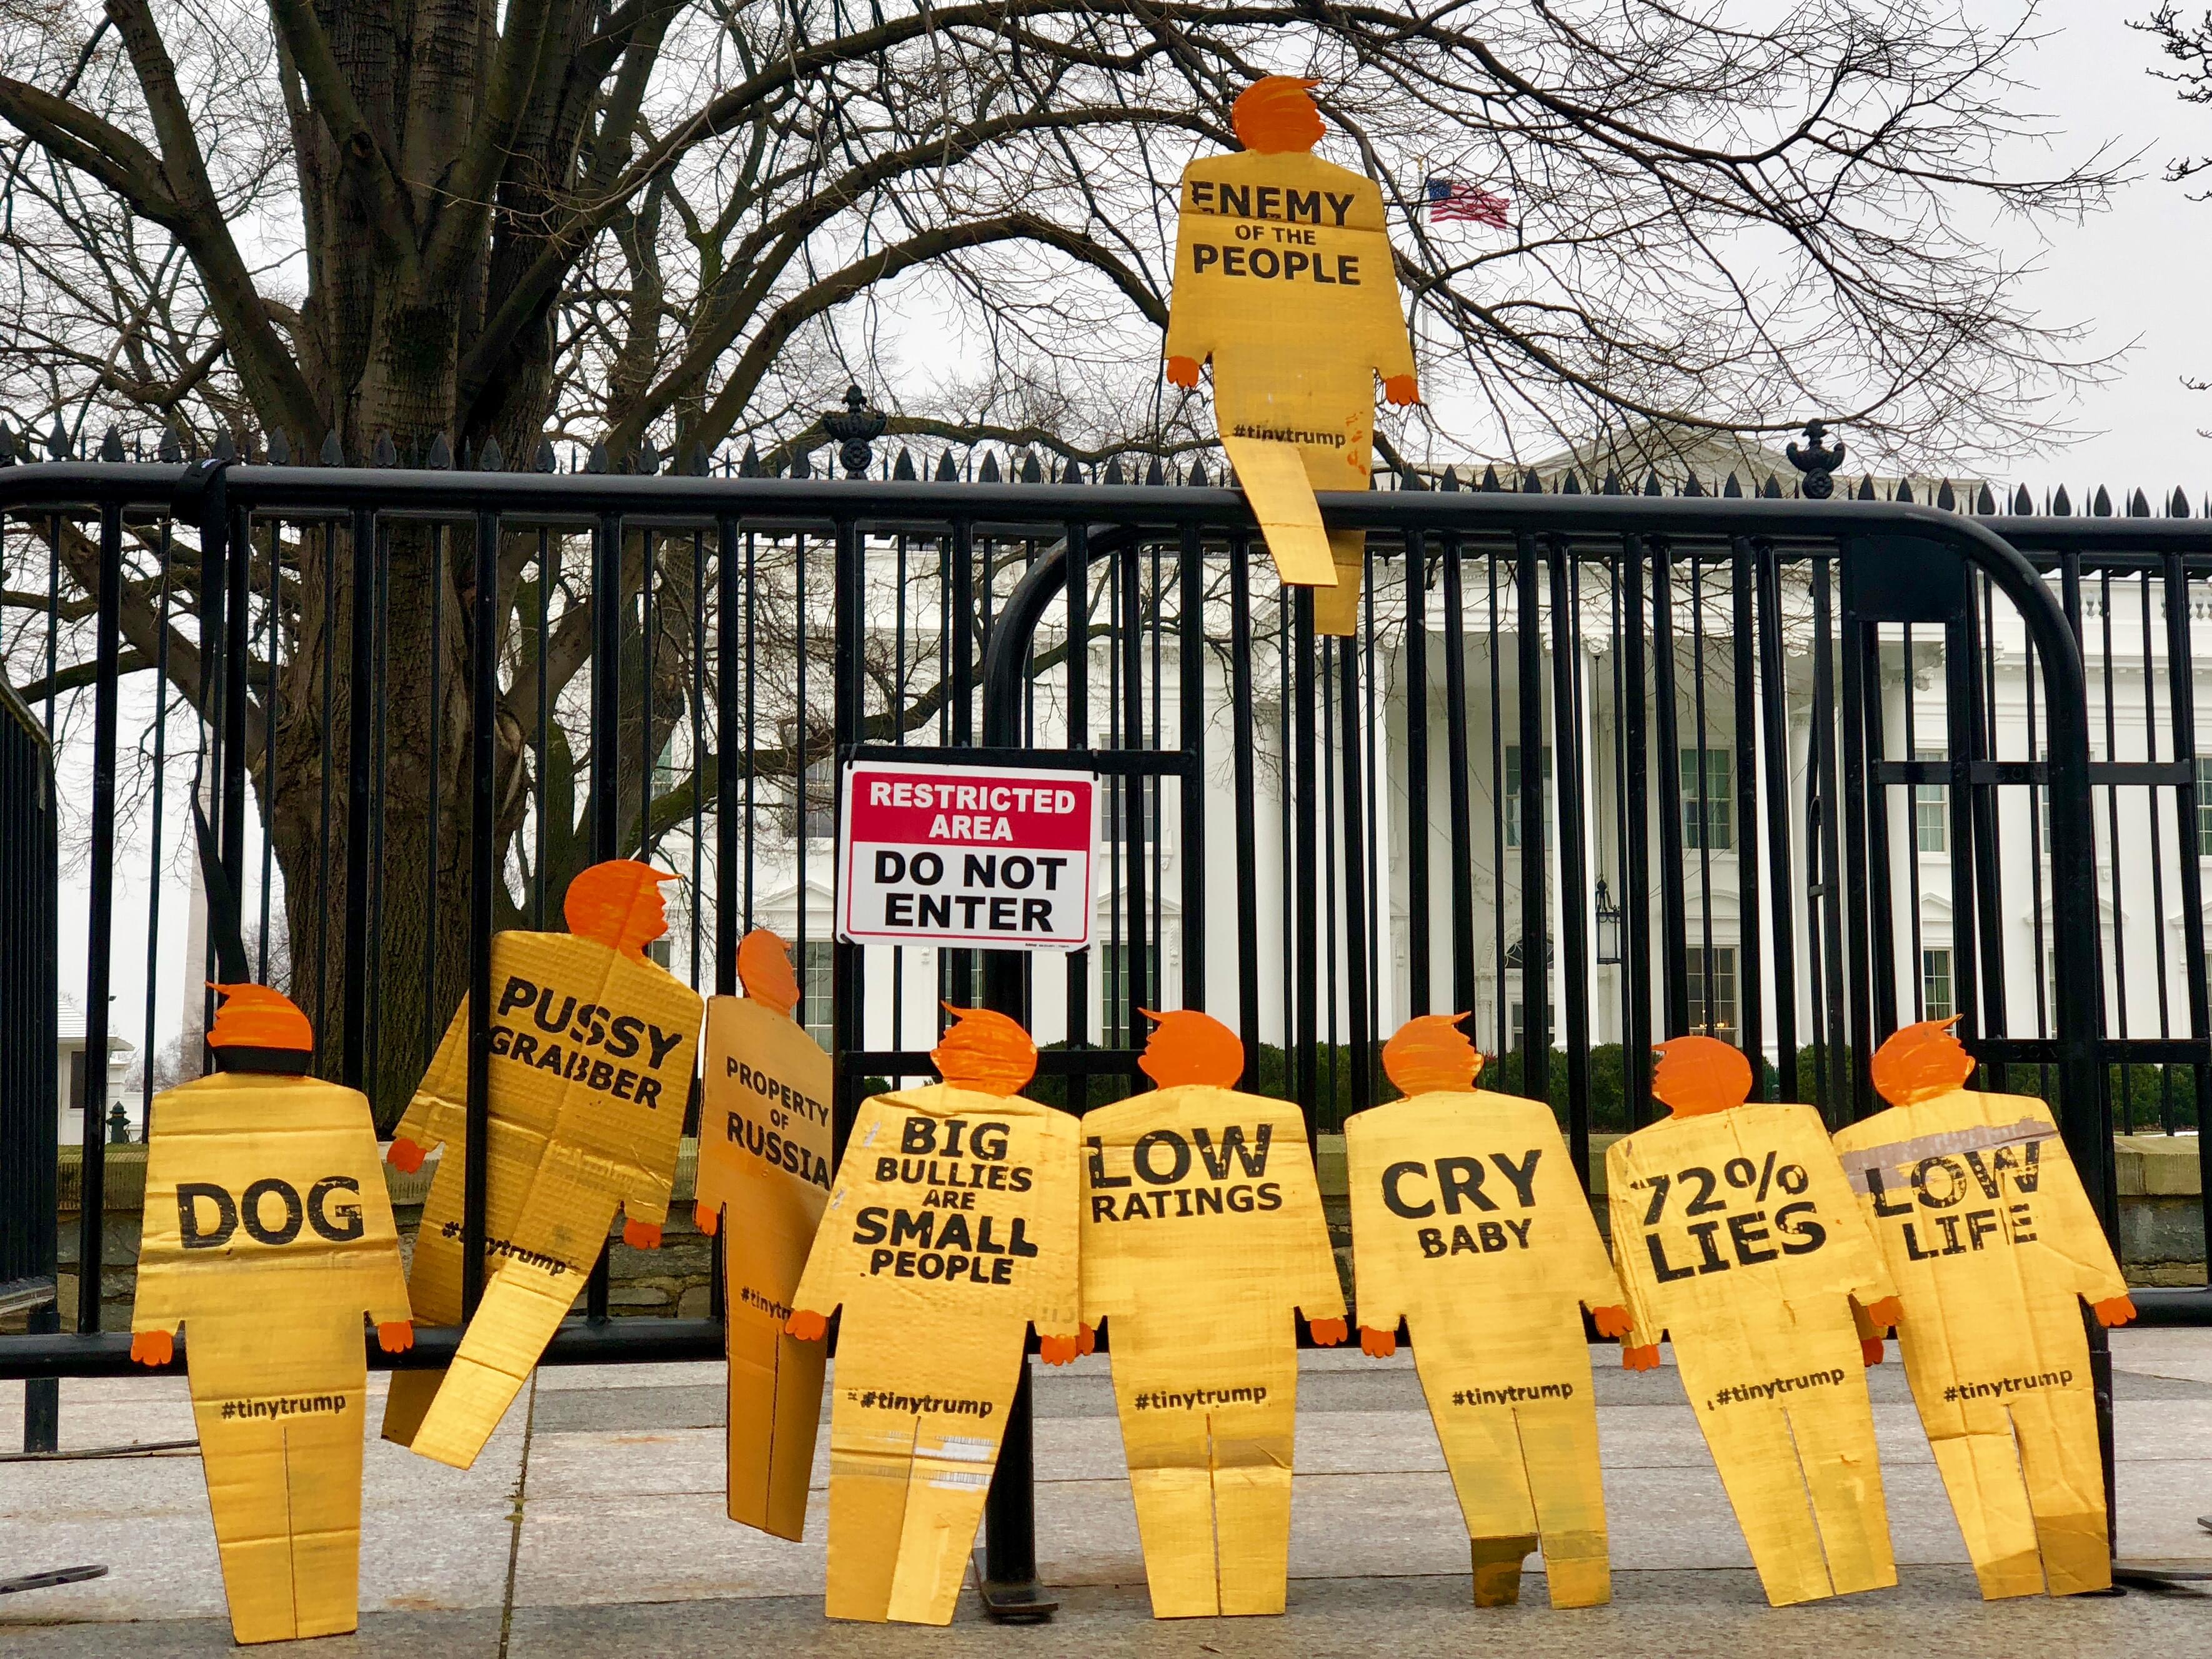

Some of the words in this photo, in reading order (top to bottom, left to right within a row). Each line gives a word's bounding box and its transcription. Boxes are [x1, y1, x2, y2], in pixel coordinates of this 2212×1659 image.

[1190, 181, 1355, 226] ENEMY
[1235, 225, 1264, 241] OF
[1272, 227, 1317, 245] THE
[1193, 244, 1361, 285] PEOPLE
[1233, 425, 1346, 449] #tinytrump
[870, 782, 1075, 814] RESTRICTED
[929, 814, 1013, 840] AREA
[875, 850, 944, 885] DO
[964, 854, 1067, 890] NOT
[885, 893, 1054, 932] ENTER
[497, 976, 683, 1070] PUSSY
[489, 1026, 662, 1109] GRABBER
[727, 1057, 829, 1127] PROPERTY
[770, 1108, 789, 1130] OF
[900, 1117, 1010, 1161] BIG
[727, 1112, 830, 1191] RUSSIA
[1087, 1123, 1273, 1189] LOW
[875, 1157, 1033, 1192] BULLIES
[1381, 1149, 1542, 1219] CRY
[1630, 1150, 1809, 1226] 72%
[1865, 1140, 2040, 1217] LOW
[176, 1176, 364, 1248] DOG
[922, 1190, 975, 1210] ARE
[1091, 1183, 1282, 1223] RATINGS
[853, 1207, 1038, 1257] SMALL
[1418, 1218, 1532, 1258] BABY
[1645, 1202, 1826, 1283] LIES
[1903, 1203, 2038, 1261] LIFE
[870, 1249, 1014, 1285] PEOPLE
[860, 1391, 993, 1418] #tinytrump
[1135, 1385, 1267, 1411] #tinytrump
[1452, 1382, 1573, 1406] #tinytrump
[1716, 1368, 1845, 1405] #tinytrump
[1943, 1369, 2073, 1402] #tinytrump
[221, 1395, 346, 1420] #tinytrump
